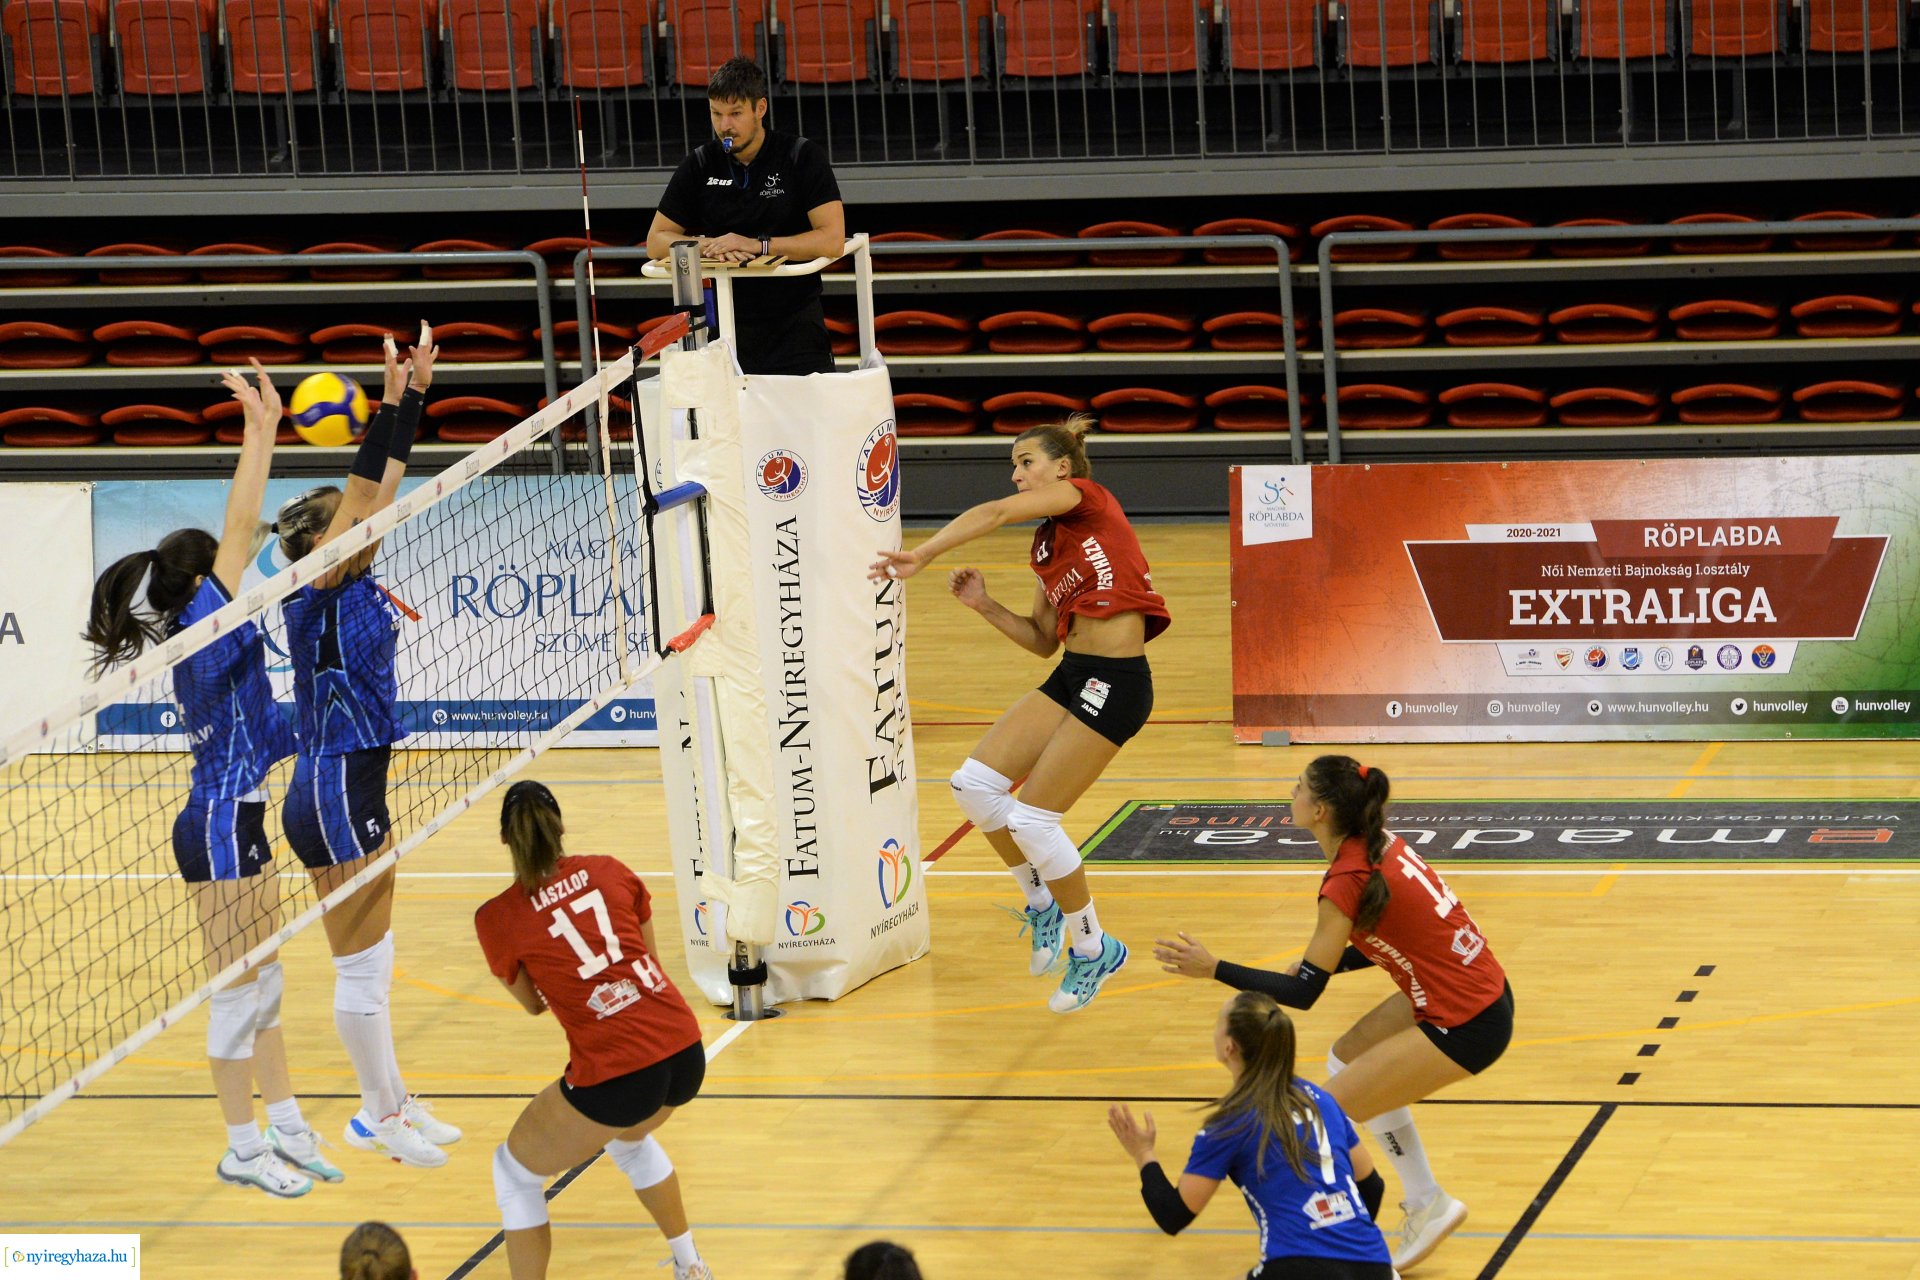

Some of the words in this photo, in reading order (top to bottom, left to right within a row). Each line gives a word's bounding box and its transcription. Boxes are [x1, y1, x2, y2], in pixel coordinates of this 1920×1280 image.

[859, 423, 893, 471] FATUM
[757, 451, 784, 477] FATUM
[1249, 511, 1304, 521] RÖPLABDA
[1506, 527, 1562, 538] 2020-2021
[1643, 523, 1782, 547] RÖPLABDA
[1541, 564, 1564, 577] Női
[1567, 563, 1621, 577] Nemzeti
[1624, 563, 1693, 579] Bajnokság
[1695, 562, 1750, 577] I.osztály
[1508, 586, 1777, 625] EXTRALIGA
[1081, 702, 1099, 717] JAKO
[1405, 702, 1459, 714] hunvolley
[1507, 702, 1561, 714] hunvolley
[1607, 701, 1709, 714] www.hunvolley.hu
[1753, 700, 1808, 714] hunvolley
[1855, 699, 1911, 713] hunvolley
[366, 817, 381, 838] 5
[530, 869, 590, 913] LÁSZLOP
[870, 901, 920, 940] NYÍREGYHÁZA
[547, 888, 625, 981] 17
[778, 937, 837, 950] NYÍREGYHÁZA
